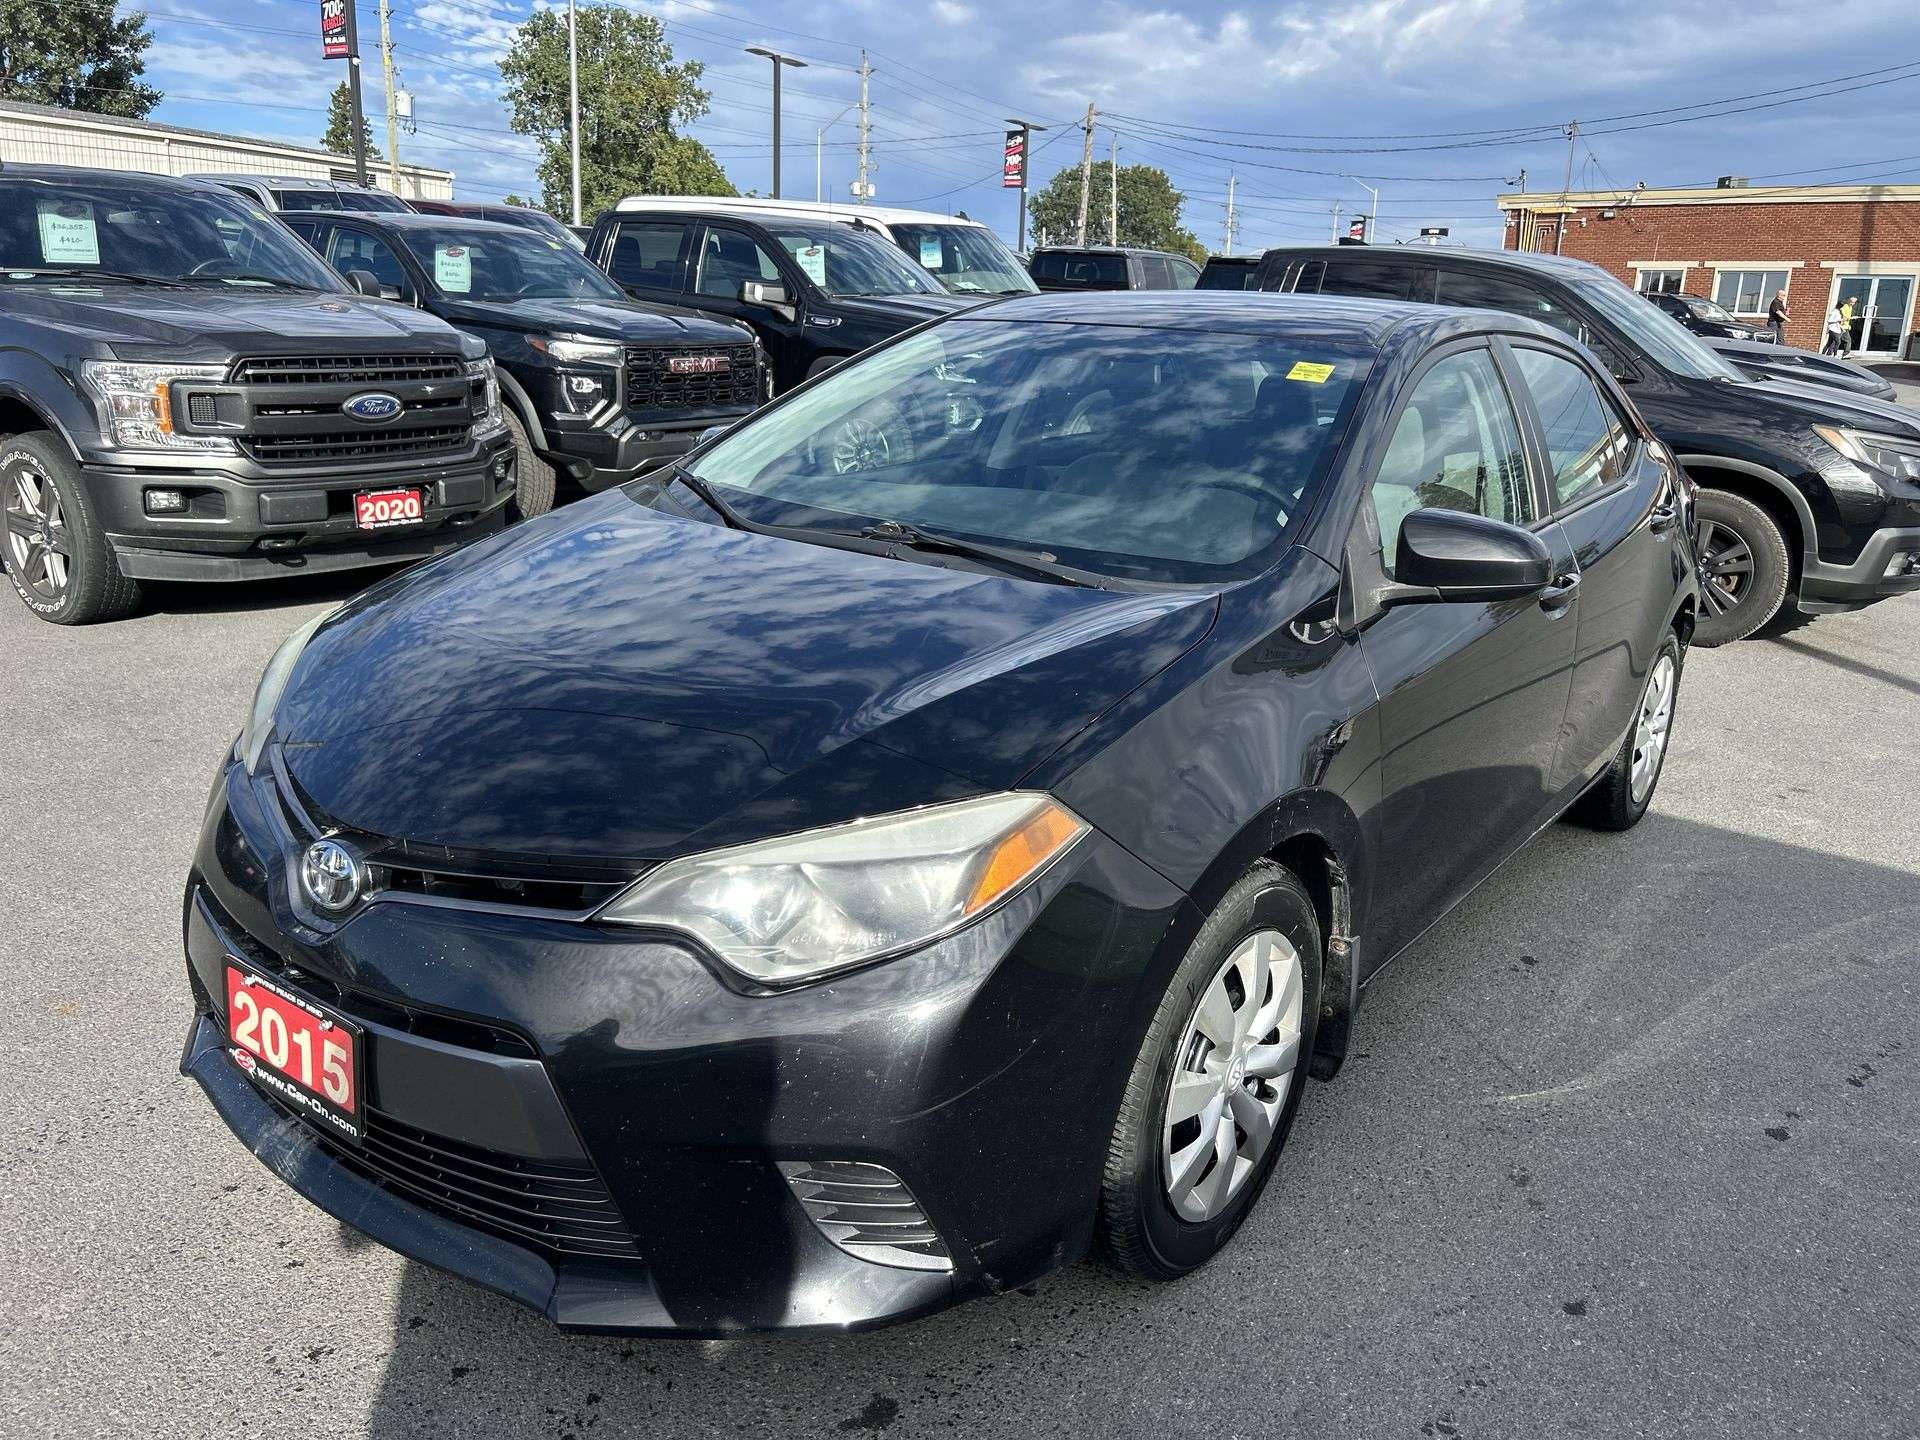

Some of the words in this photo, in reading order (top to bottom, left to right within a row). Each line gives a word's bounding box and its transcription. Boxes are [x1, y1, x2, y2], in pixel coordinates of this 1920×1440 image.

[322, 0, 344, 20] 700+
[323, 13, 345, 32] VEHICLES
[669, 356, 730, 373] GMC
[362, 399, 391, 413] Ford
[0, 450, 62, 501] WRANGLER
[360, 497, 419, 523] 2020
[4, 560, 67, 613] GOODYEAR
[233, 990, 350, 1104] 2015
[256, 1065, 358, 1137] www.Car-On.com
